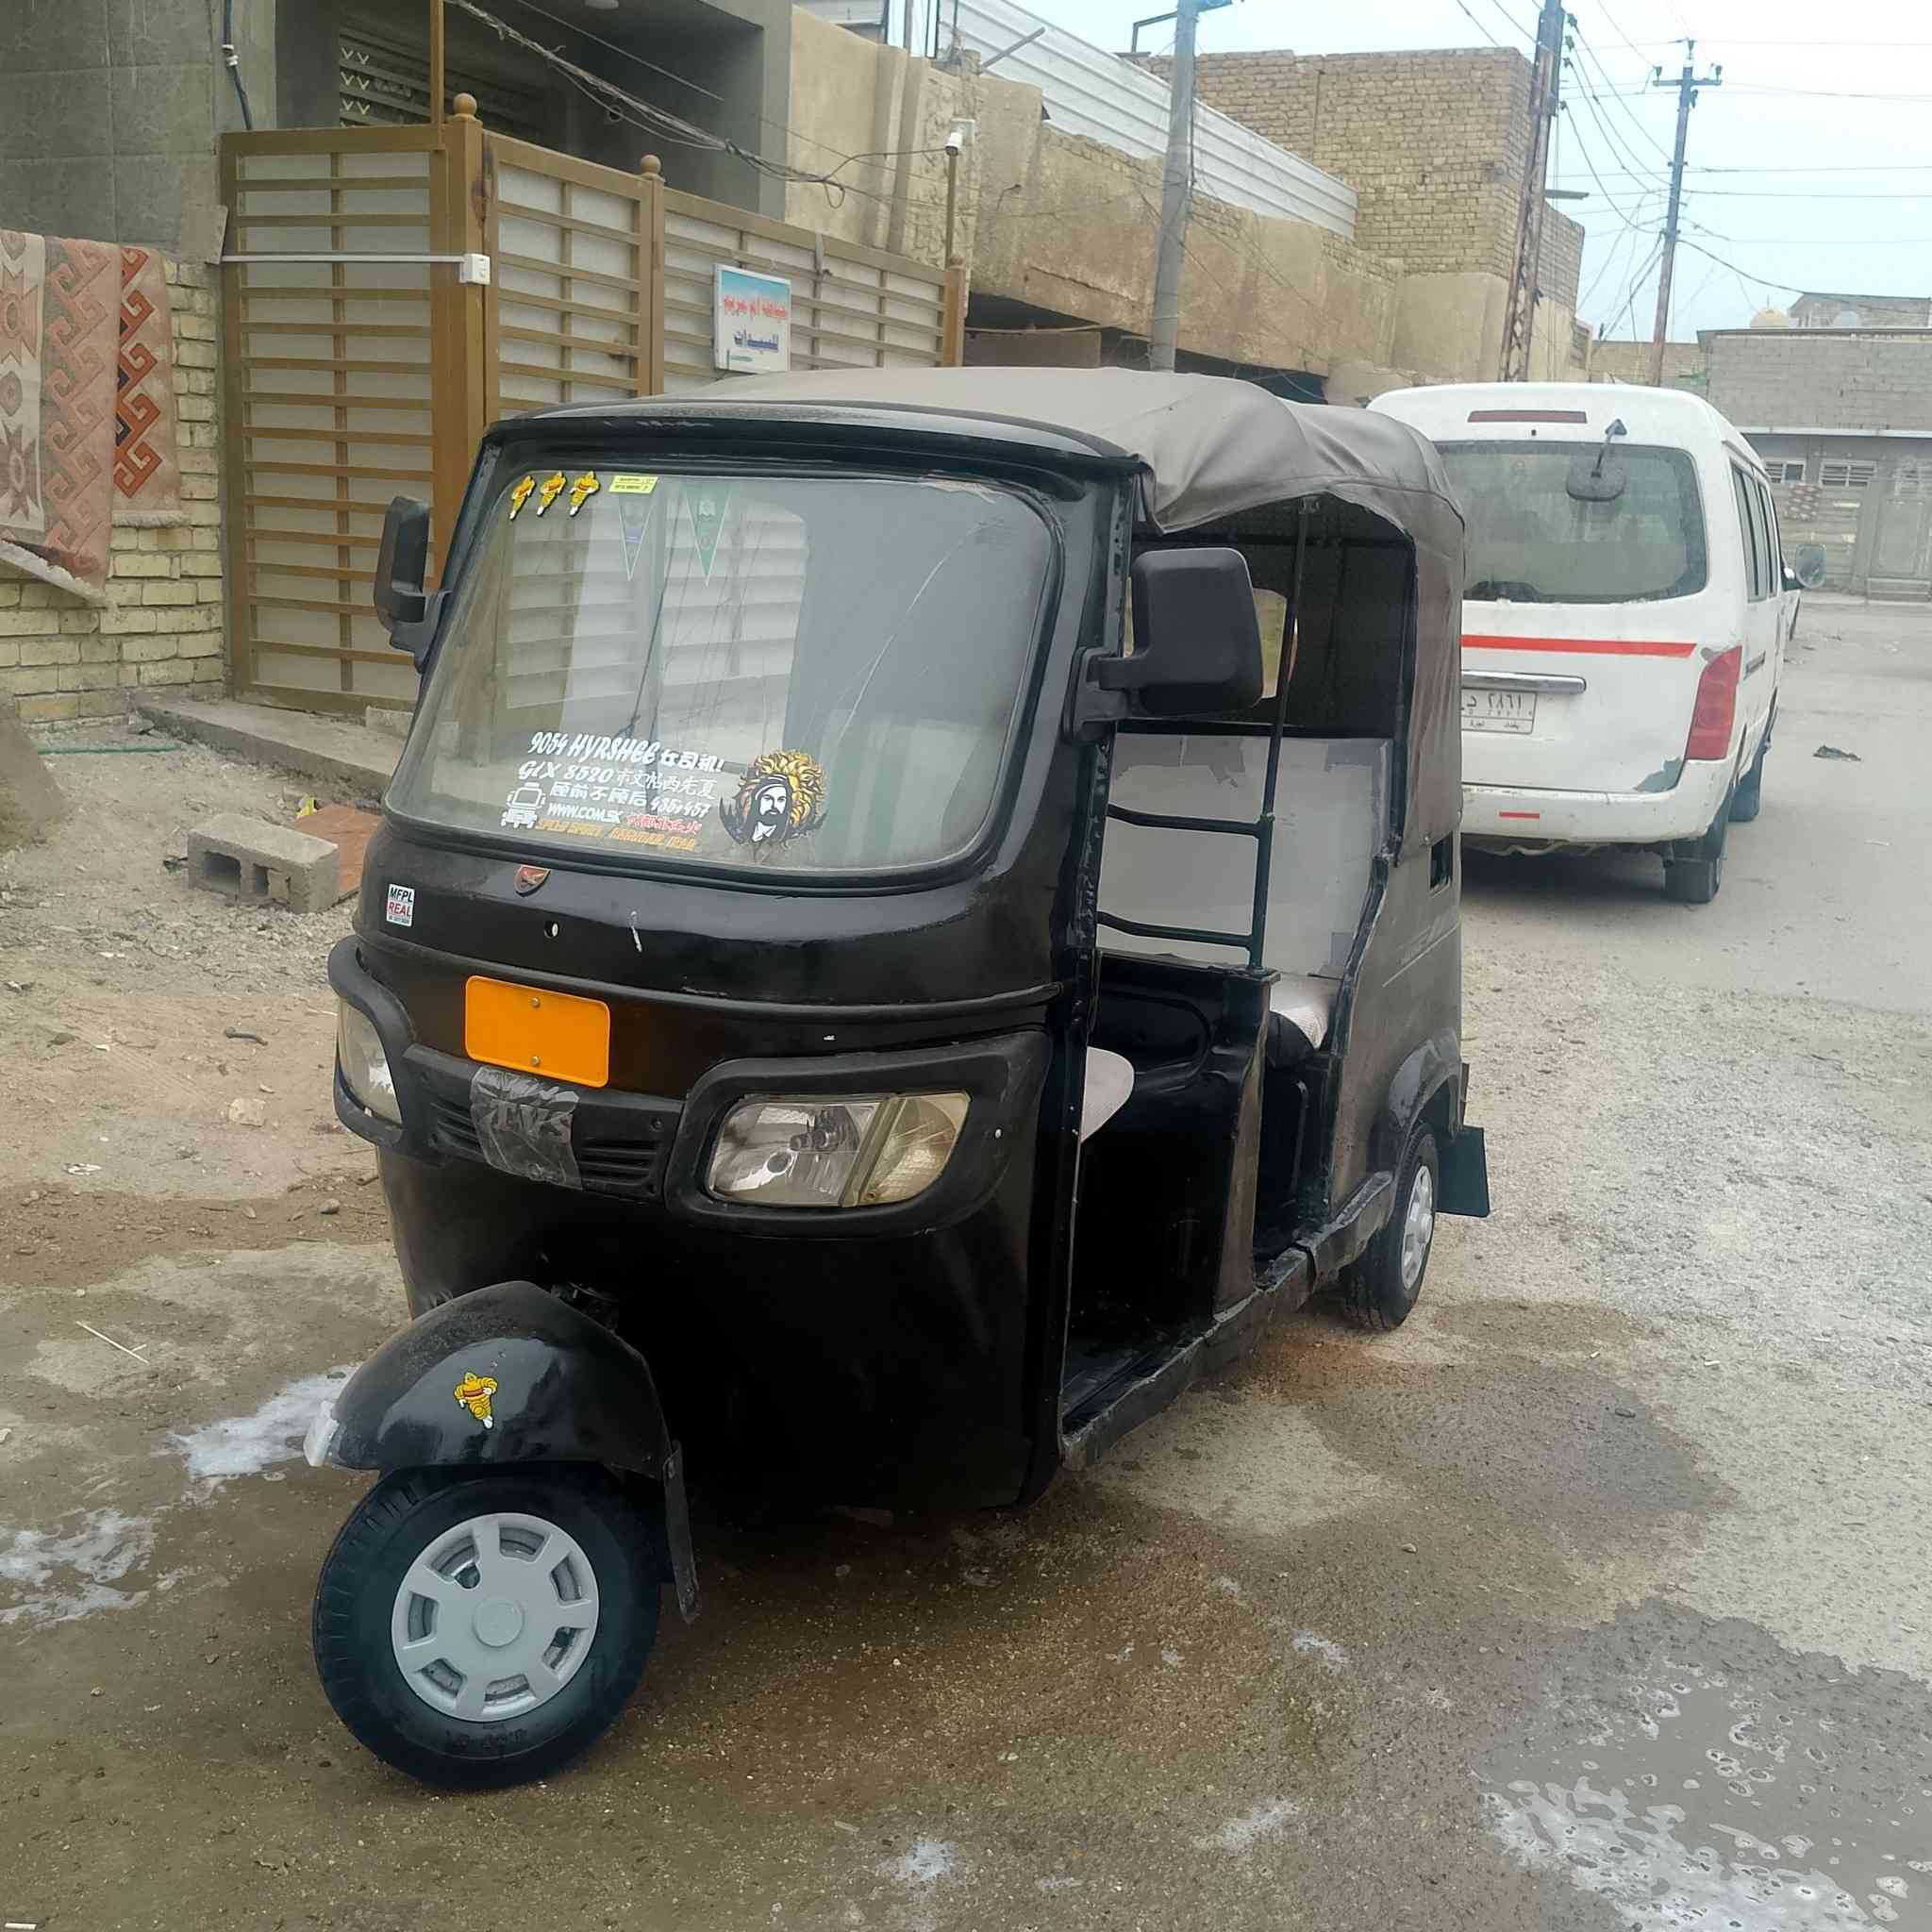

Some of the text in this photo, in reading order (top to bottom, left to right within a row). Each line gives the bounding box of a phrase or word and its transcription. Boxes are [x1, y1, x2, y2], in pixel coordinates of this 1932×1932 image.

[528, 731, 568, 755] 9054
[563, 764, 614, 784] 8520
[391, 888, 413, 903] MFPL
[389, 902, 410, 917] REAL
